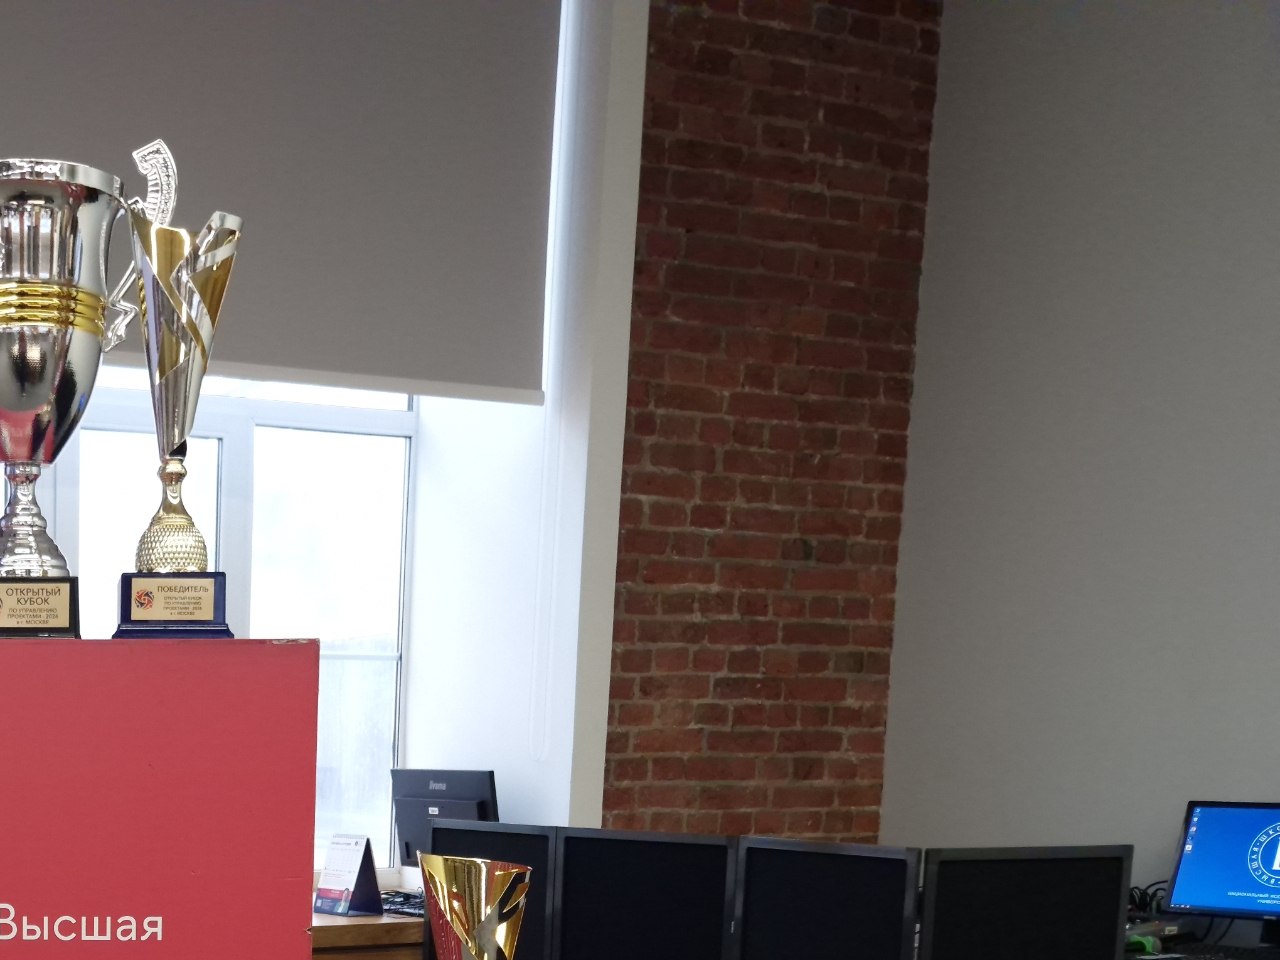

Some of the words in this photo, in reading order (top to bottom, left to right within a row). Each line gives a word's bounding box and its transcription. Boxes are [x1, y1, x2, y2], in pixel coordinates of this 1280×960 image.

[5, 586, 61, 597] ОТКРЫТЫЙ
[157, 585, 209, 593] ПОБЕДИТЕЛЬ
[16, 597, 50, 606] КУБОК
